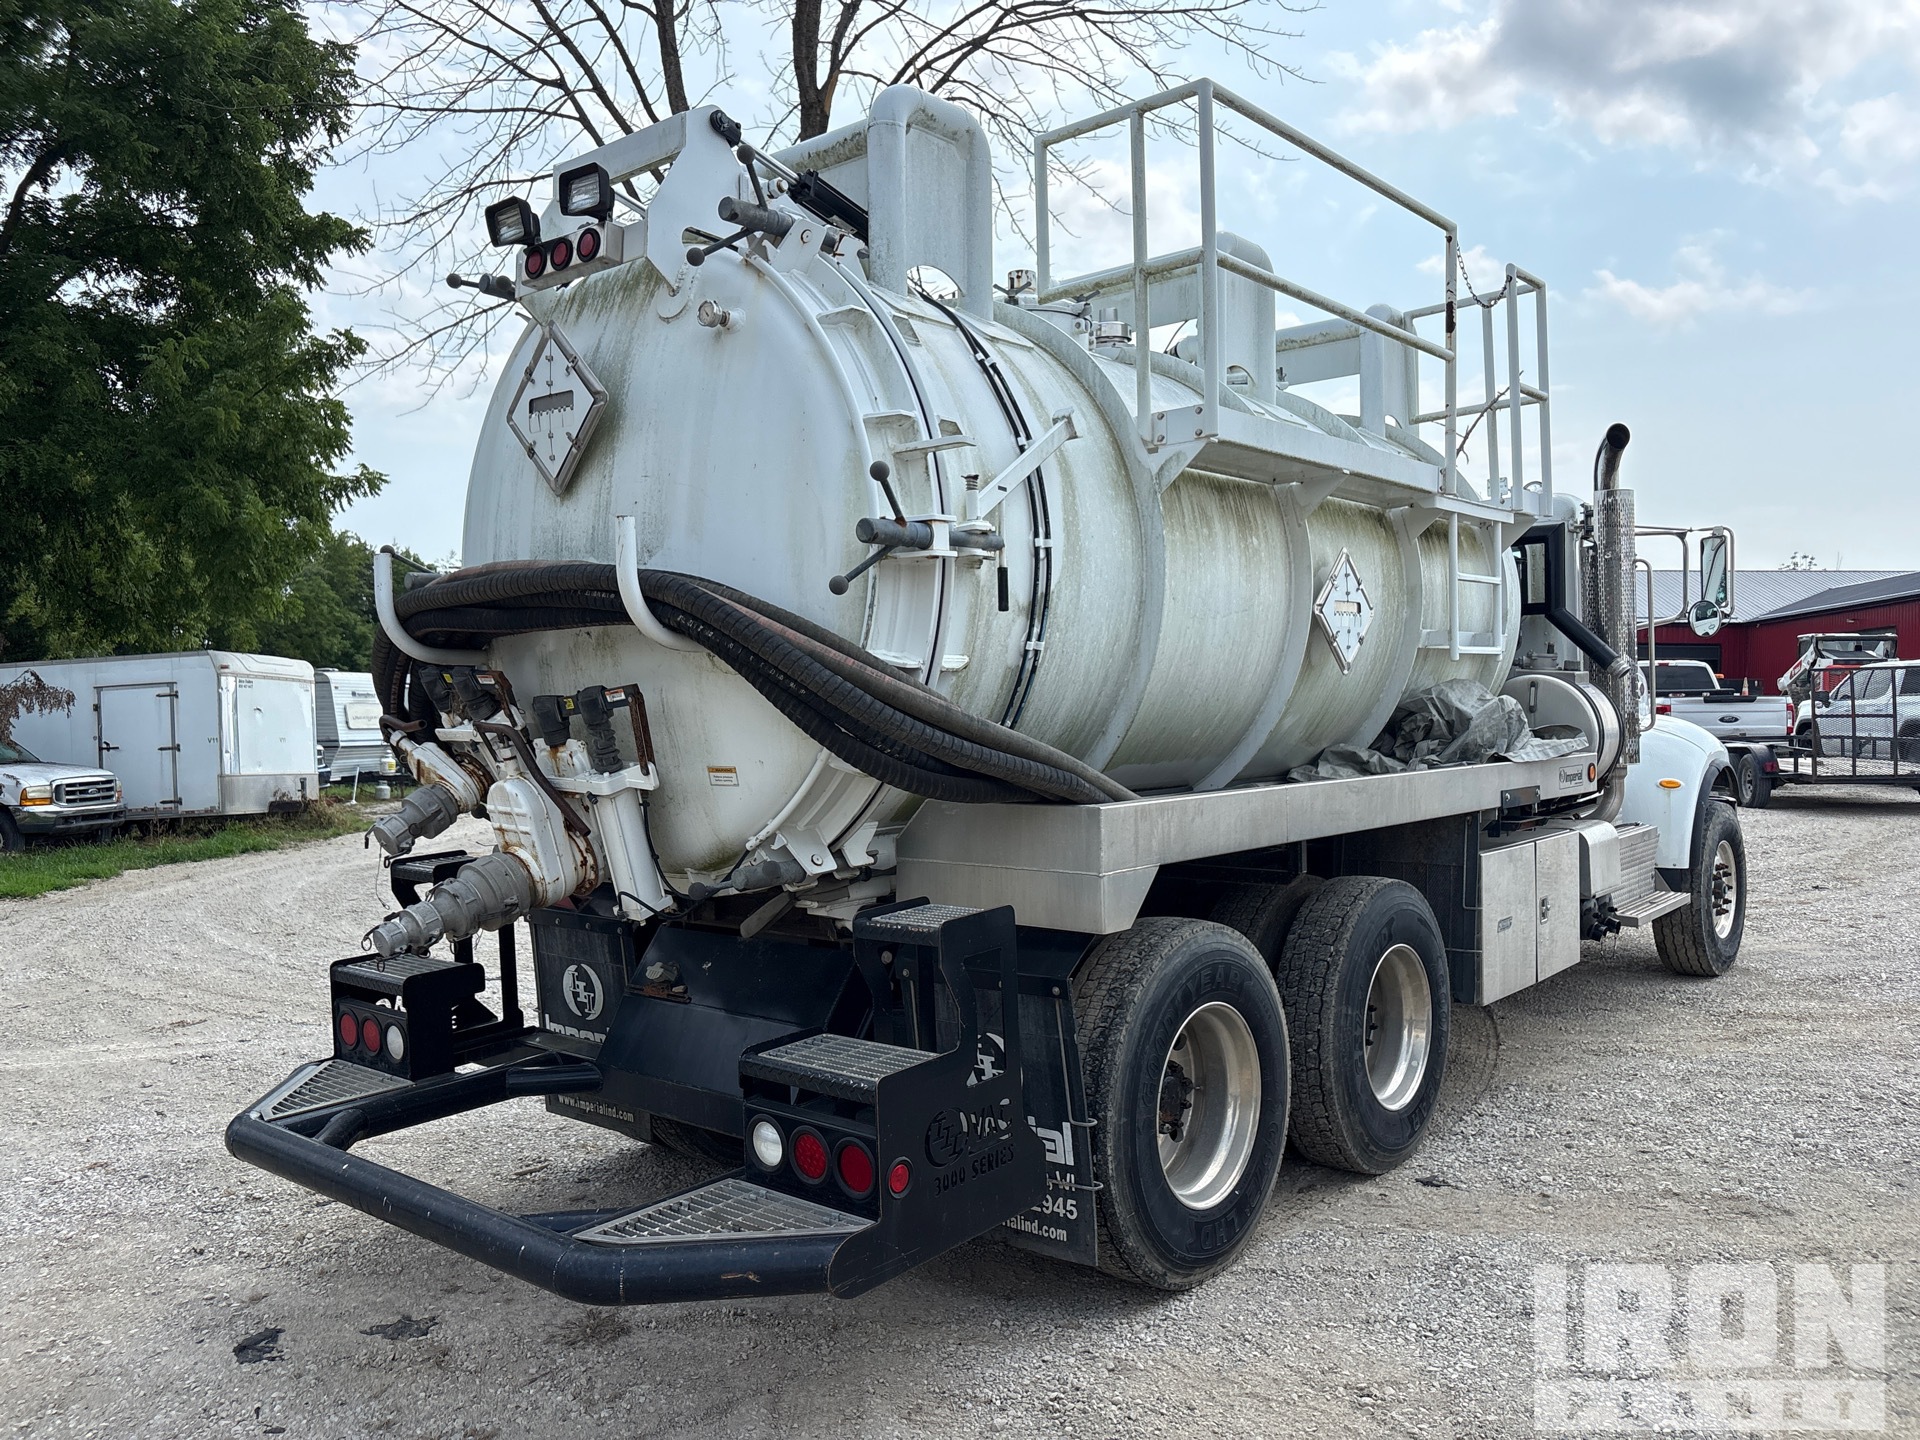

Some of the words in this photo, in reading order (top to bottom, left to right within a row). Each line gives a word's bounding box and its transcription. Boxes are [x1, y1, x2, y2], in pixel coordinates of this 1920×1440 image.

[1565, 769, 1583, 785] Imperial
[557, 1094, 634, 1122] www.imperialind.com
[934, 1166, 967, 1197] 3000
[971, 1144, 1015, 1180] SERIES
